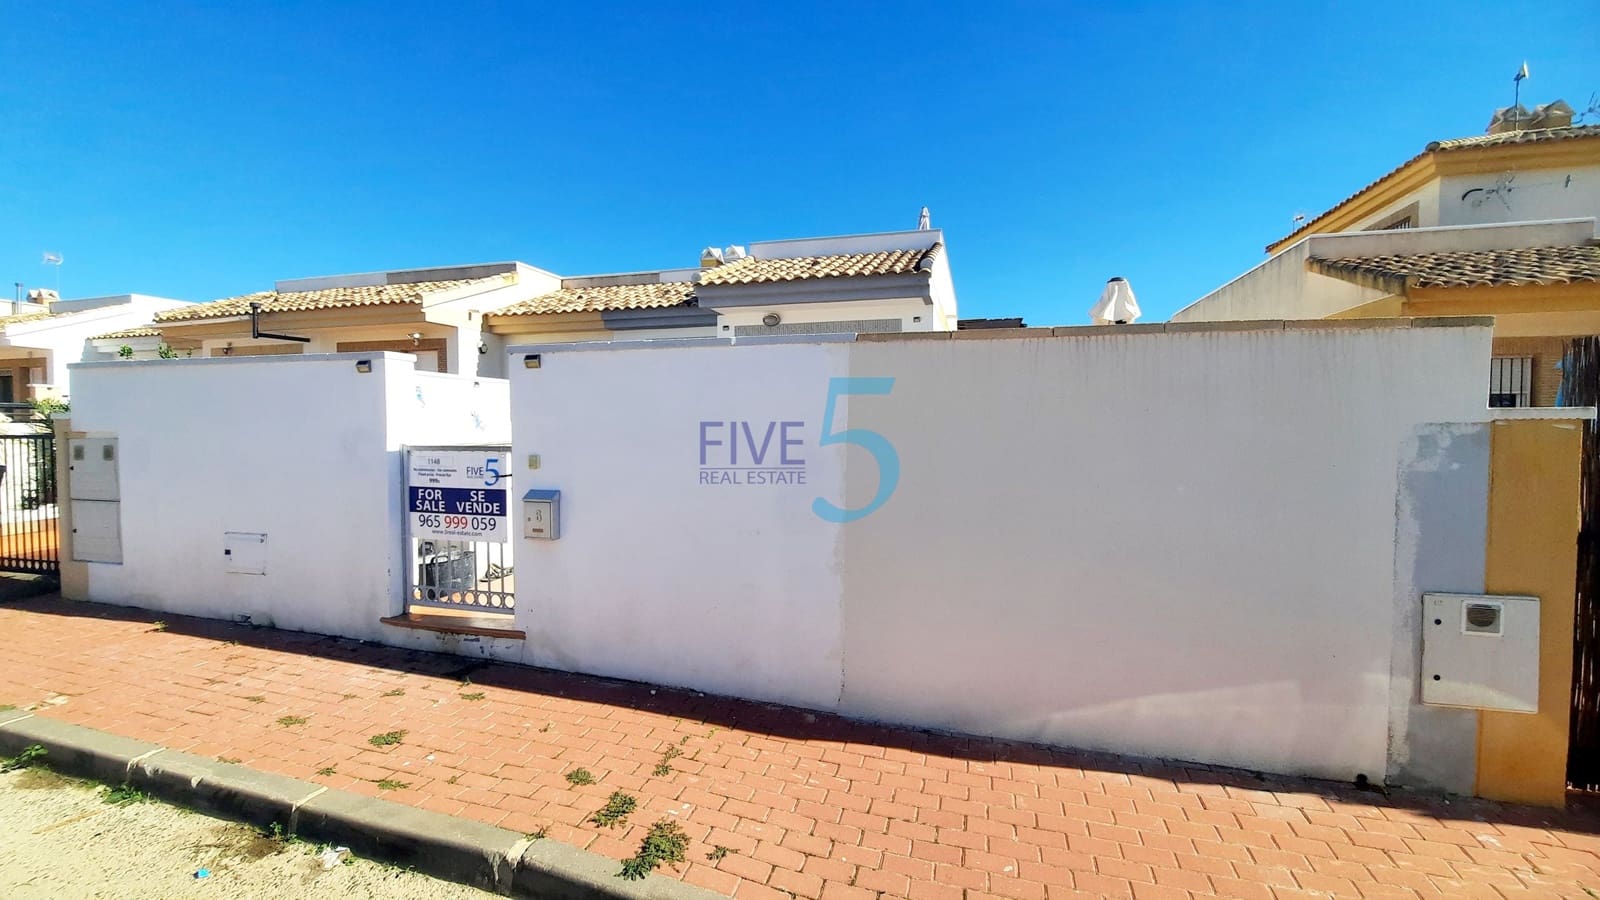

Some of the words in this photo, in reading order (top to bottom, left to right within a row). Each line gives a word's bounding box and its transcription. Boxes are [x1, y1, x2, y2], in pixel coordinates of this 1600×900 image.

[466, 466, 484, 476] FIVE
[484, 458, 499, 487] 5
[418, 488, 443, 501] FOR
[470, 490, 486, 502] SE
[416, 500, 446, 512] SALE
[456, 501, 501, 514] VENDE
[418, 514, 441, 528] 965
[444, 515, 468, 530] 999
[471, 516, 497, 531] 059
